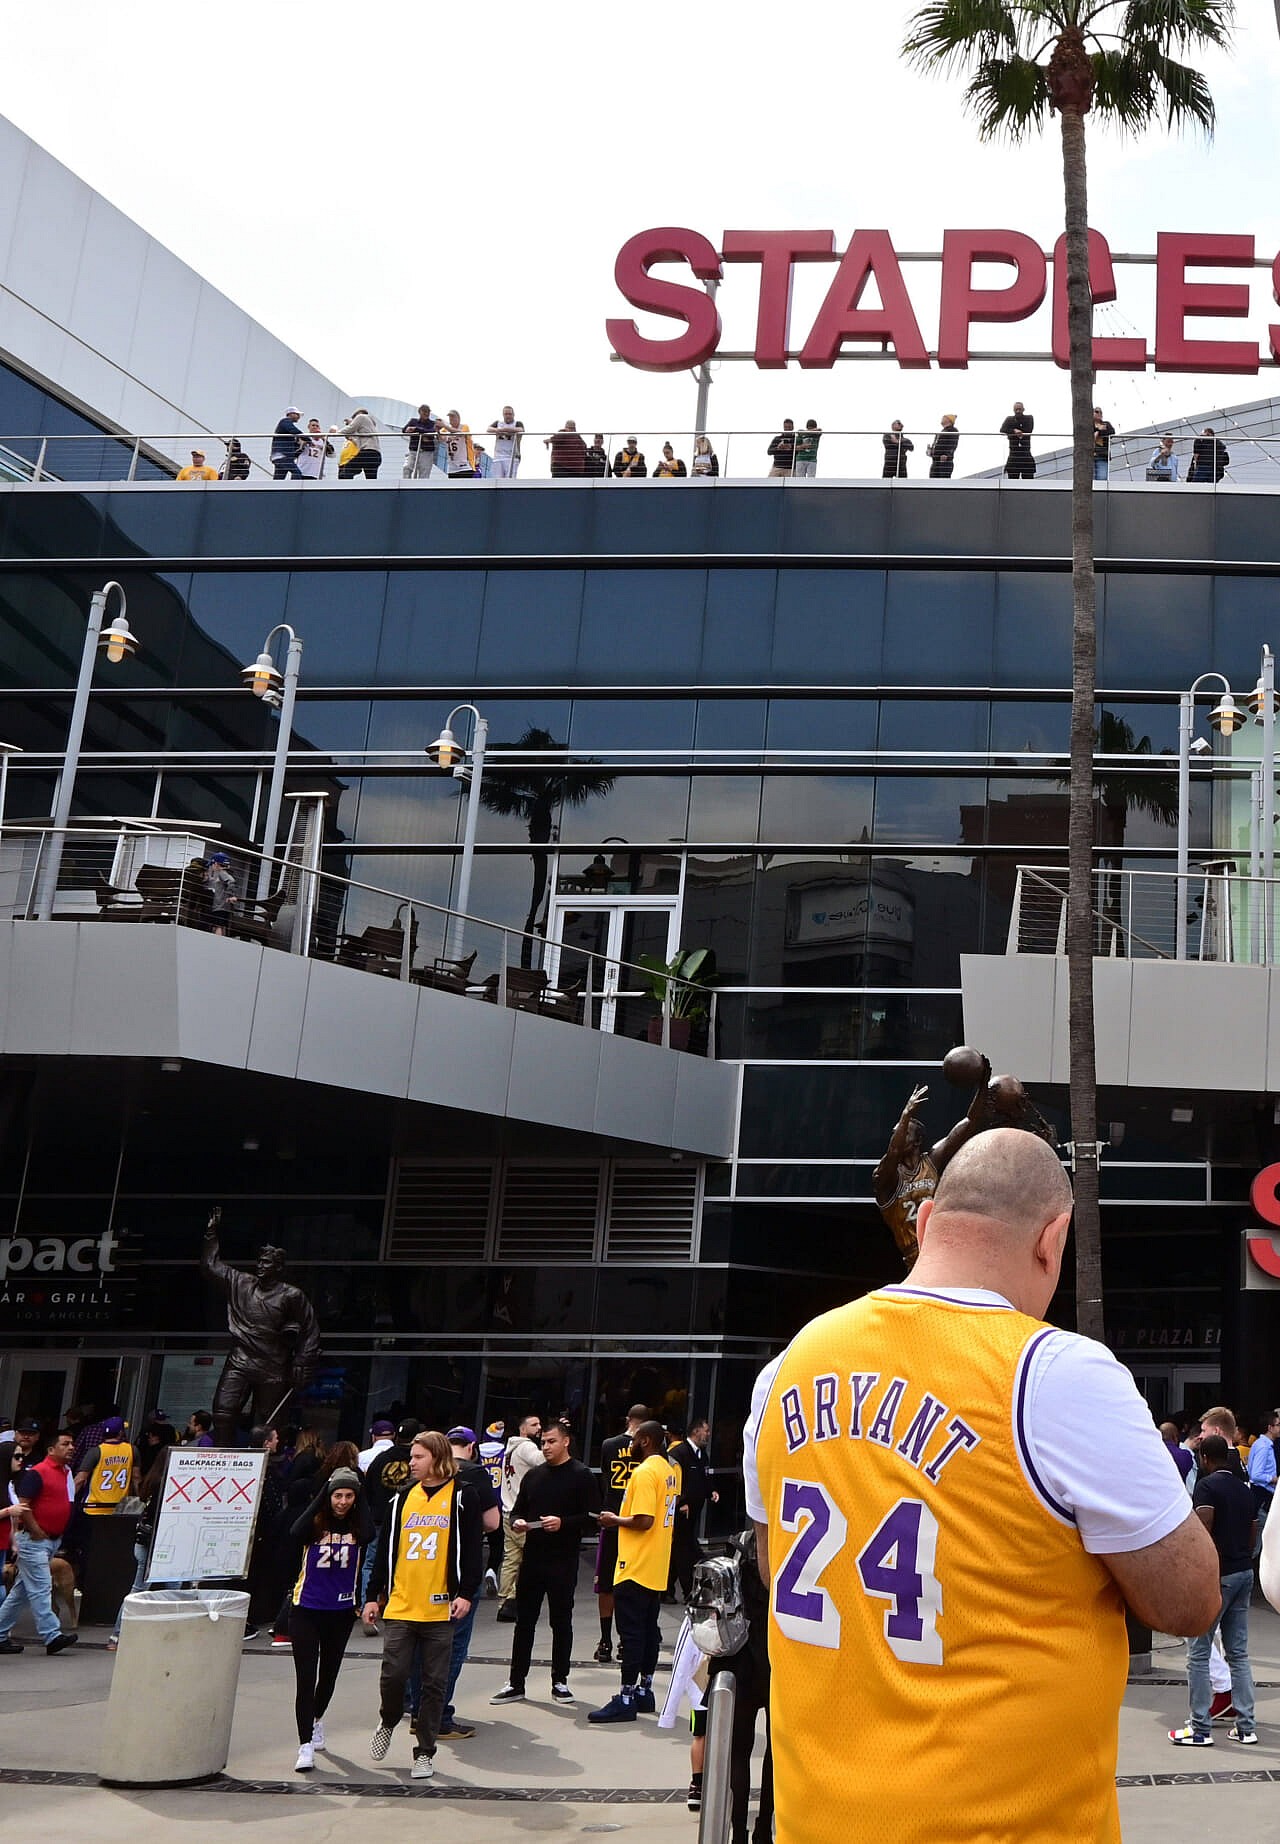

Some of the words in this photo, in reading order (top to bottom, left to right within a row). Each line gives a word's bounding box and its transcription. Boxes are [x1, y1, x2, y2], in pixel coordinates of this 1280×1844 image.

[51, 1292, 113, 1303] GRILL
[1137, 1328, 1194, 1344] PLAZA
[780, 1372, 983, 1485] BRYANT
[179, 1459, 227, 1467] BACKPACKS
[100, 1468, 127, 1490] 24
[485, 1466, 501, 1489] 3
[403, 1512, 449, 1528] LAKERS
[316, 1545, 349, 1568] 24
[406, 1532, 438, 1560] 24
[772, 1477, 944, 1666] 24
